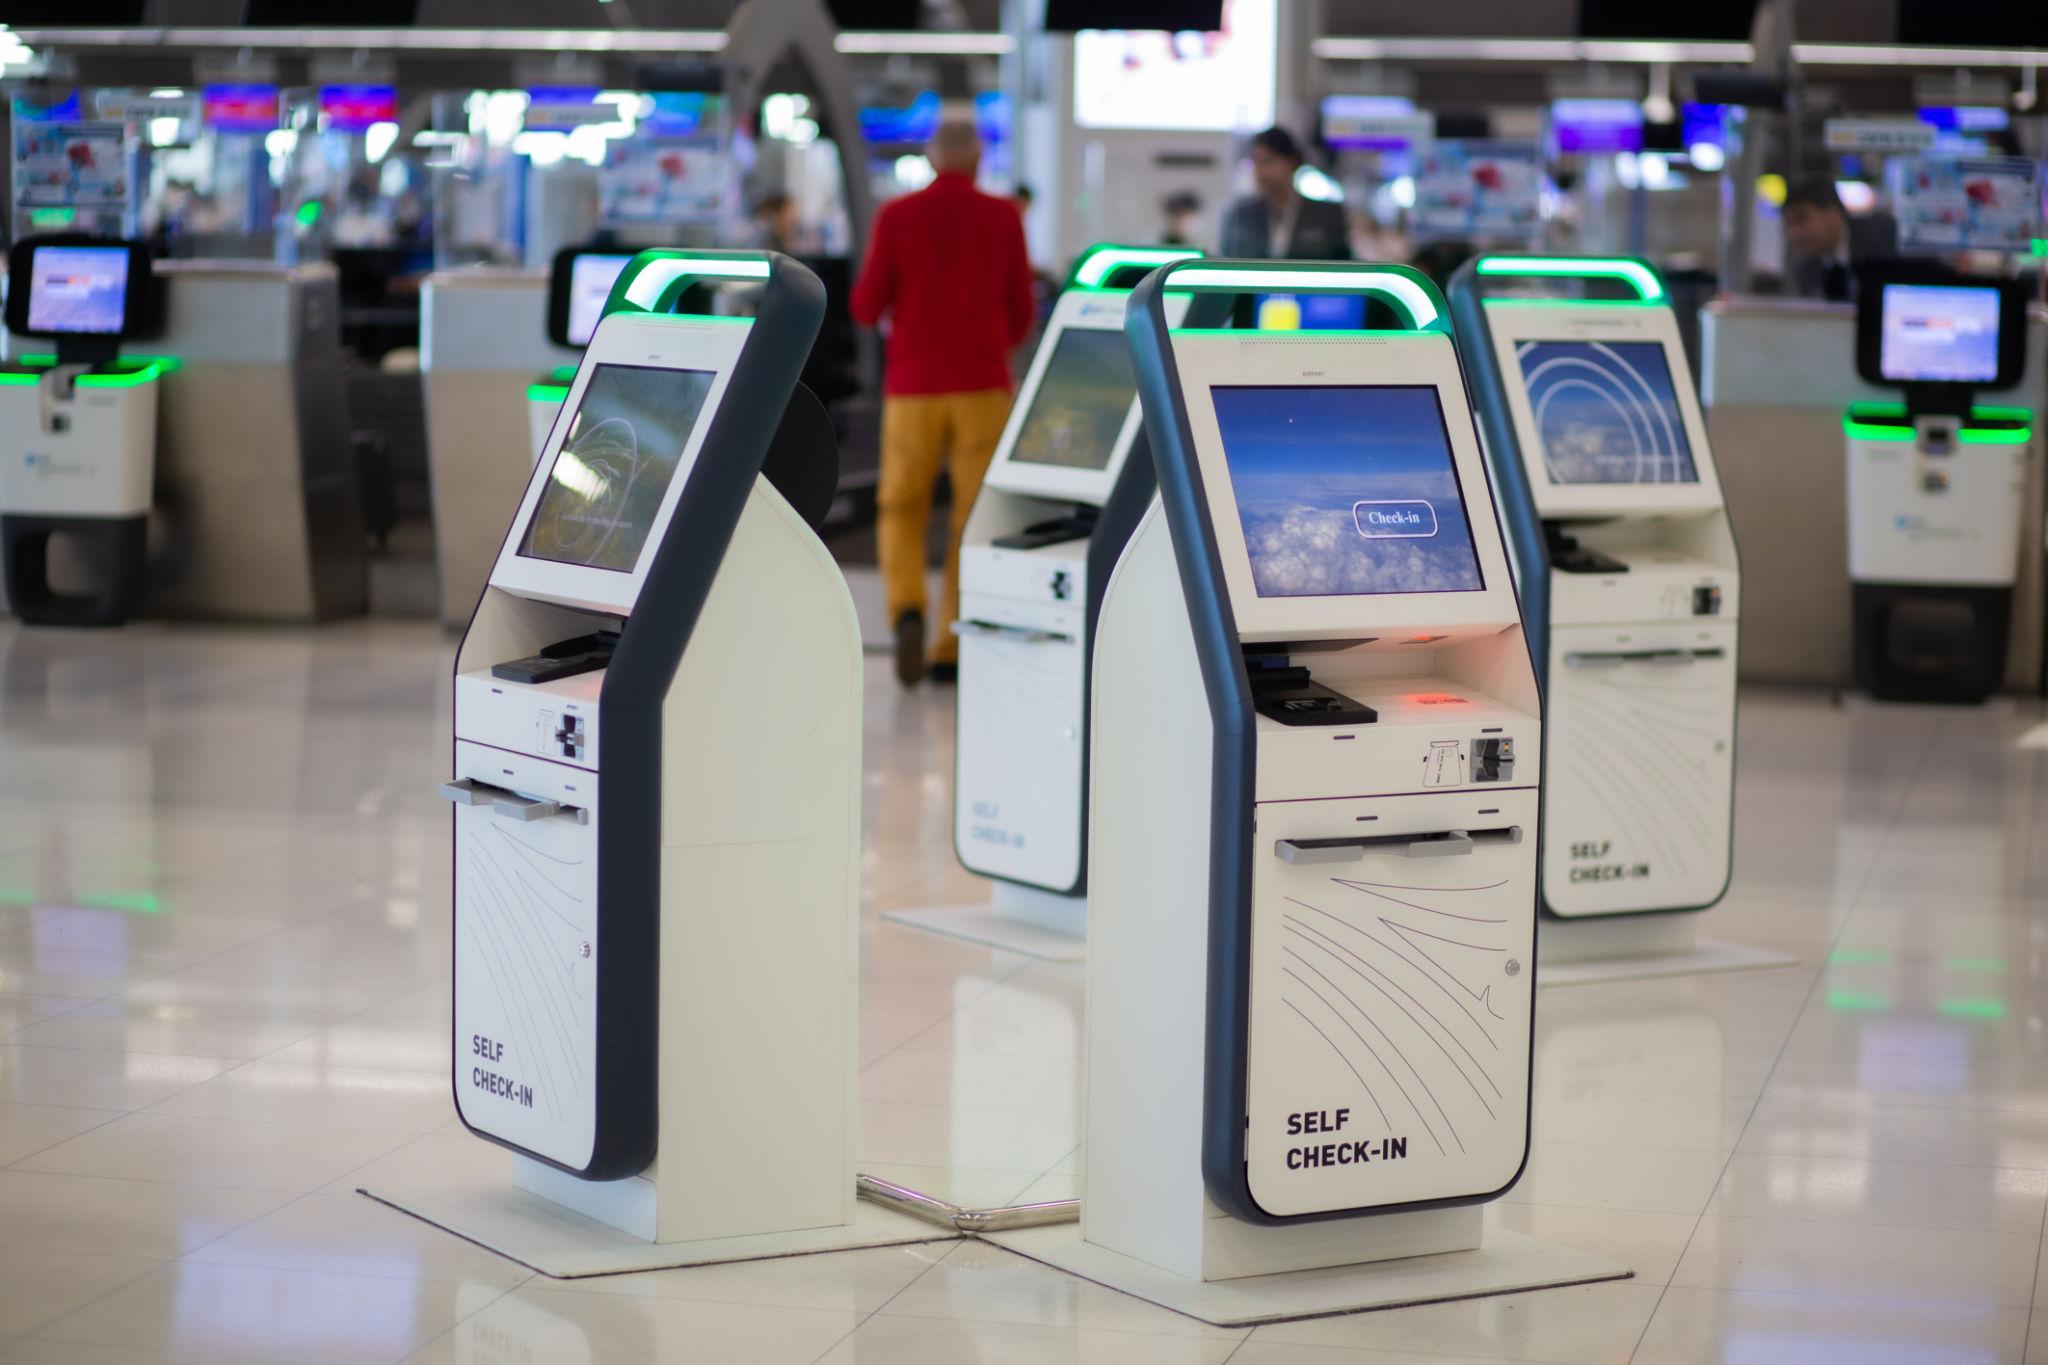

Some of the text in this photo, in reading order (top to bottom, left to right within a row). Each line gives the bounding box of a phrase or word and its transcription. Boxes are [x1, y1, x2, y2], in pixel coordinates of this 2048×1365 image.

[1368, 510, 1420, 524] Check-in
[1570, 841, 1612, 859] SELF
[1569, 863, 1650, 885] CHECK-IN
[473, 1034, 504, 1063] SELF
[473, 1066, 533, 1109] CHECK-IN
[1286, 1108, 1350, 1137] SELF
[1286, 1136, 1407, 1170] CHECK-IN
